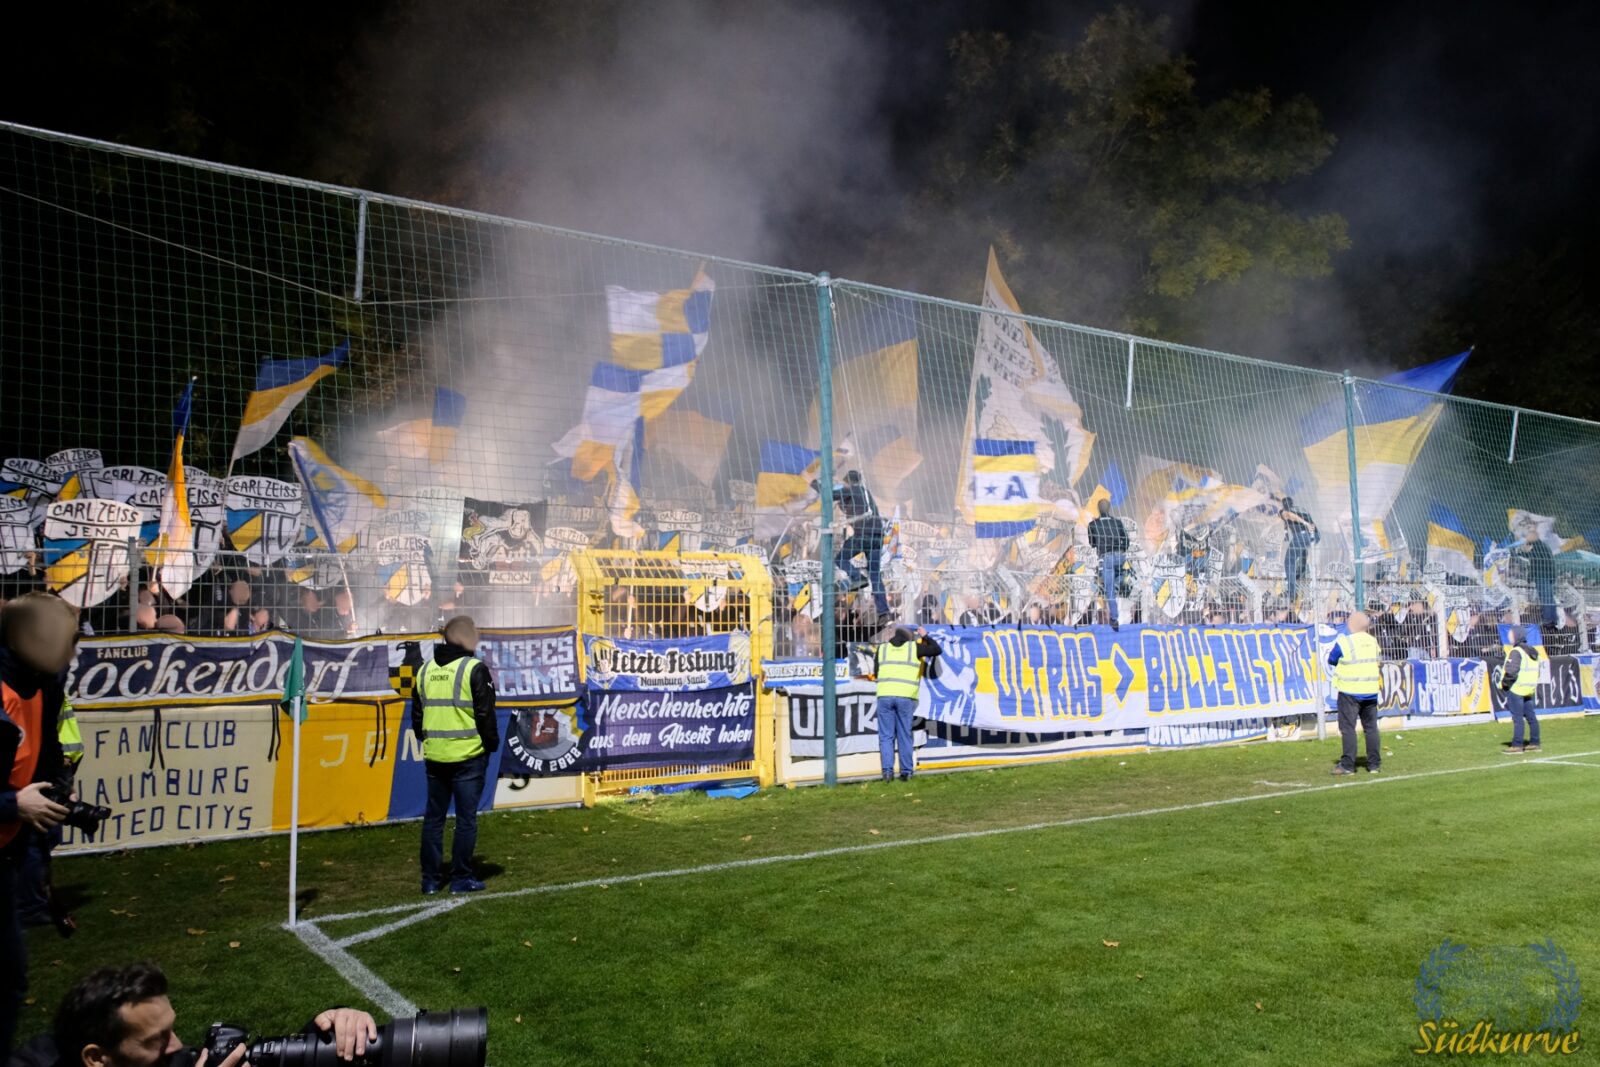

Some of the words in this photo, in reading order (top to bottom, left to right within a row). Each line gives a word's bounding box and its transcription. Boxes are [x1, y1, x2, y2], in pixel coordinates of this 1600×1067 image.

[8, 459, 33, 475] CARL
[139, 470, 166, 485] ZEIS
[185, 487, 219, 506] EISS
[233, 480, 261, 496] CARL
[264, 480, 297, 498] ZEISS
[1004, 475, 1028, 500] A
[53, 502, 95, 521] CARL
[97, 502, 139, 523] ZEISS
[243, 498, 286, 511] JENA
[64, 524, 120, 539] JENA
[97, 646, 149, 659] FANCLUB
[475, 635, 575, 669] FUGEES
[609, 648, 663, 674] Letzte
[667, 648, 737, 675] Festung
[495, 664, 577, 697] COME
[982, 628, 1106, 722] ULTRAS
[594, 692, 755, 726] Menschenrechte
[320, 727, 424, 768] JEN
[589, 732, 614, 750] aus
[622, 725, 652, 748] dem
[658, 722, 716, 750] Abseits
[718, 723, 753, 744] holen
[508, 735, 543, 772] QATAR
[176, 804, 253, 831] CITYS
